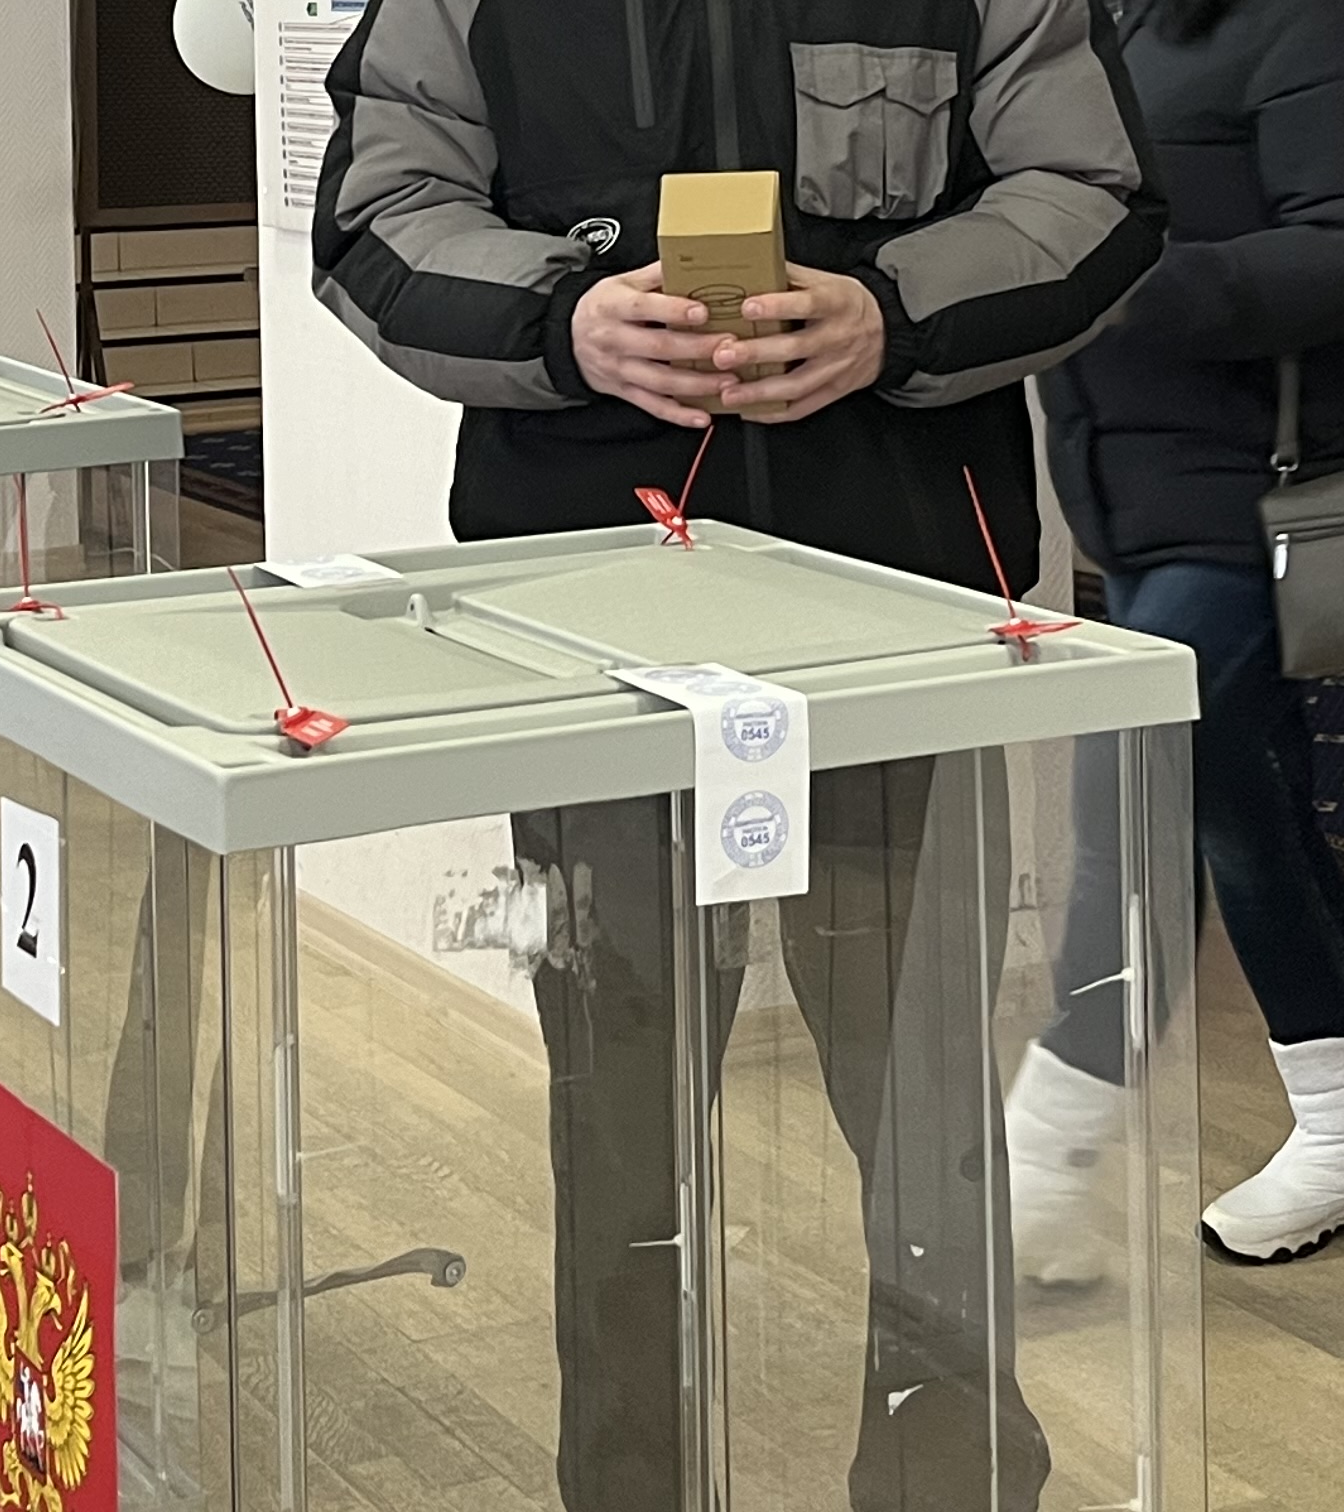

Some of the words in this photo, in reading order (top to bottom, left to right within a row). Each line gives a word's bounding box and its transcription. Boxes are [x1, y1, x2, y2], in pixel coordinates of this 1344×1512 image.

[740, 727, 770, 742] 0545
[740, 832, 770, 848] 0545
[16, 842, 40, 959] 2
